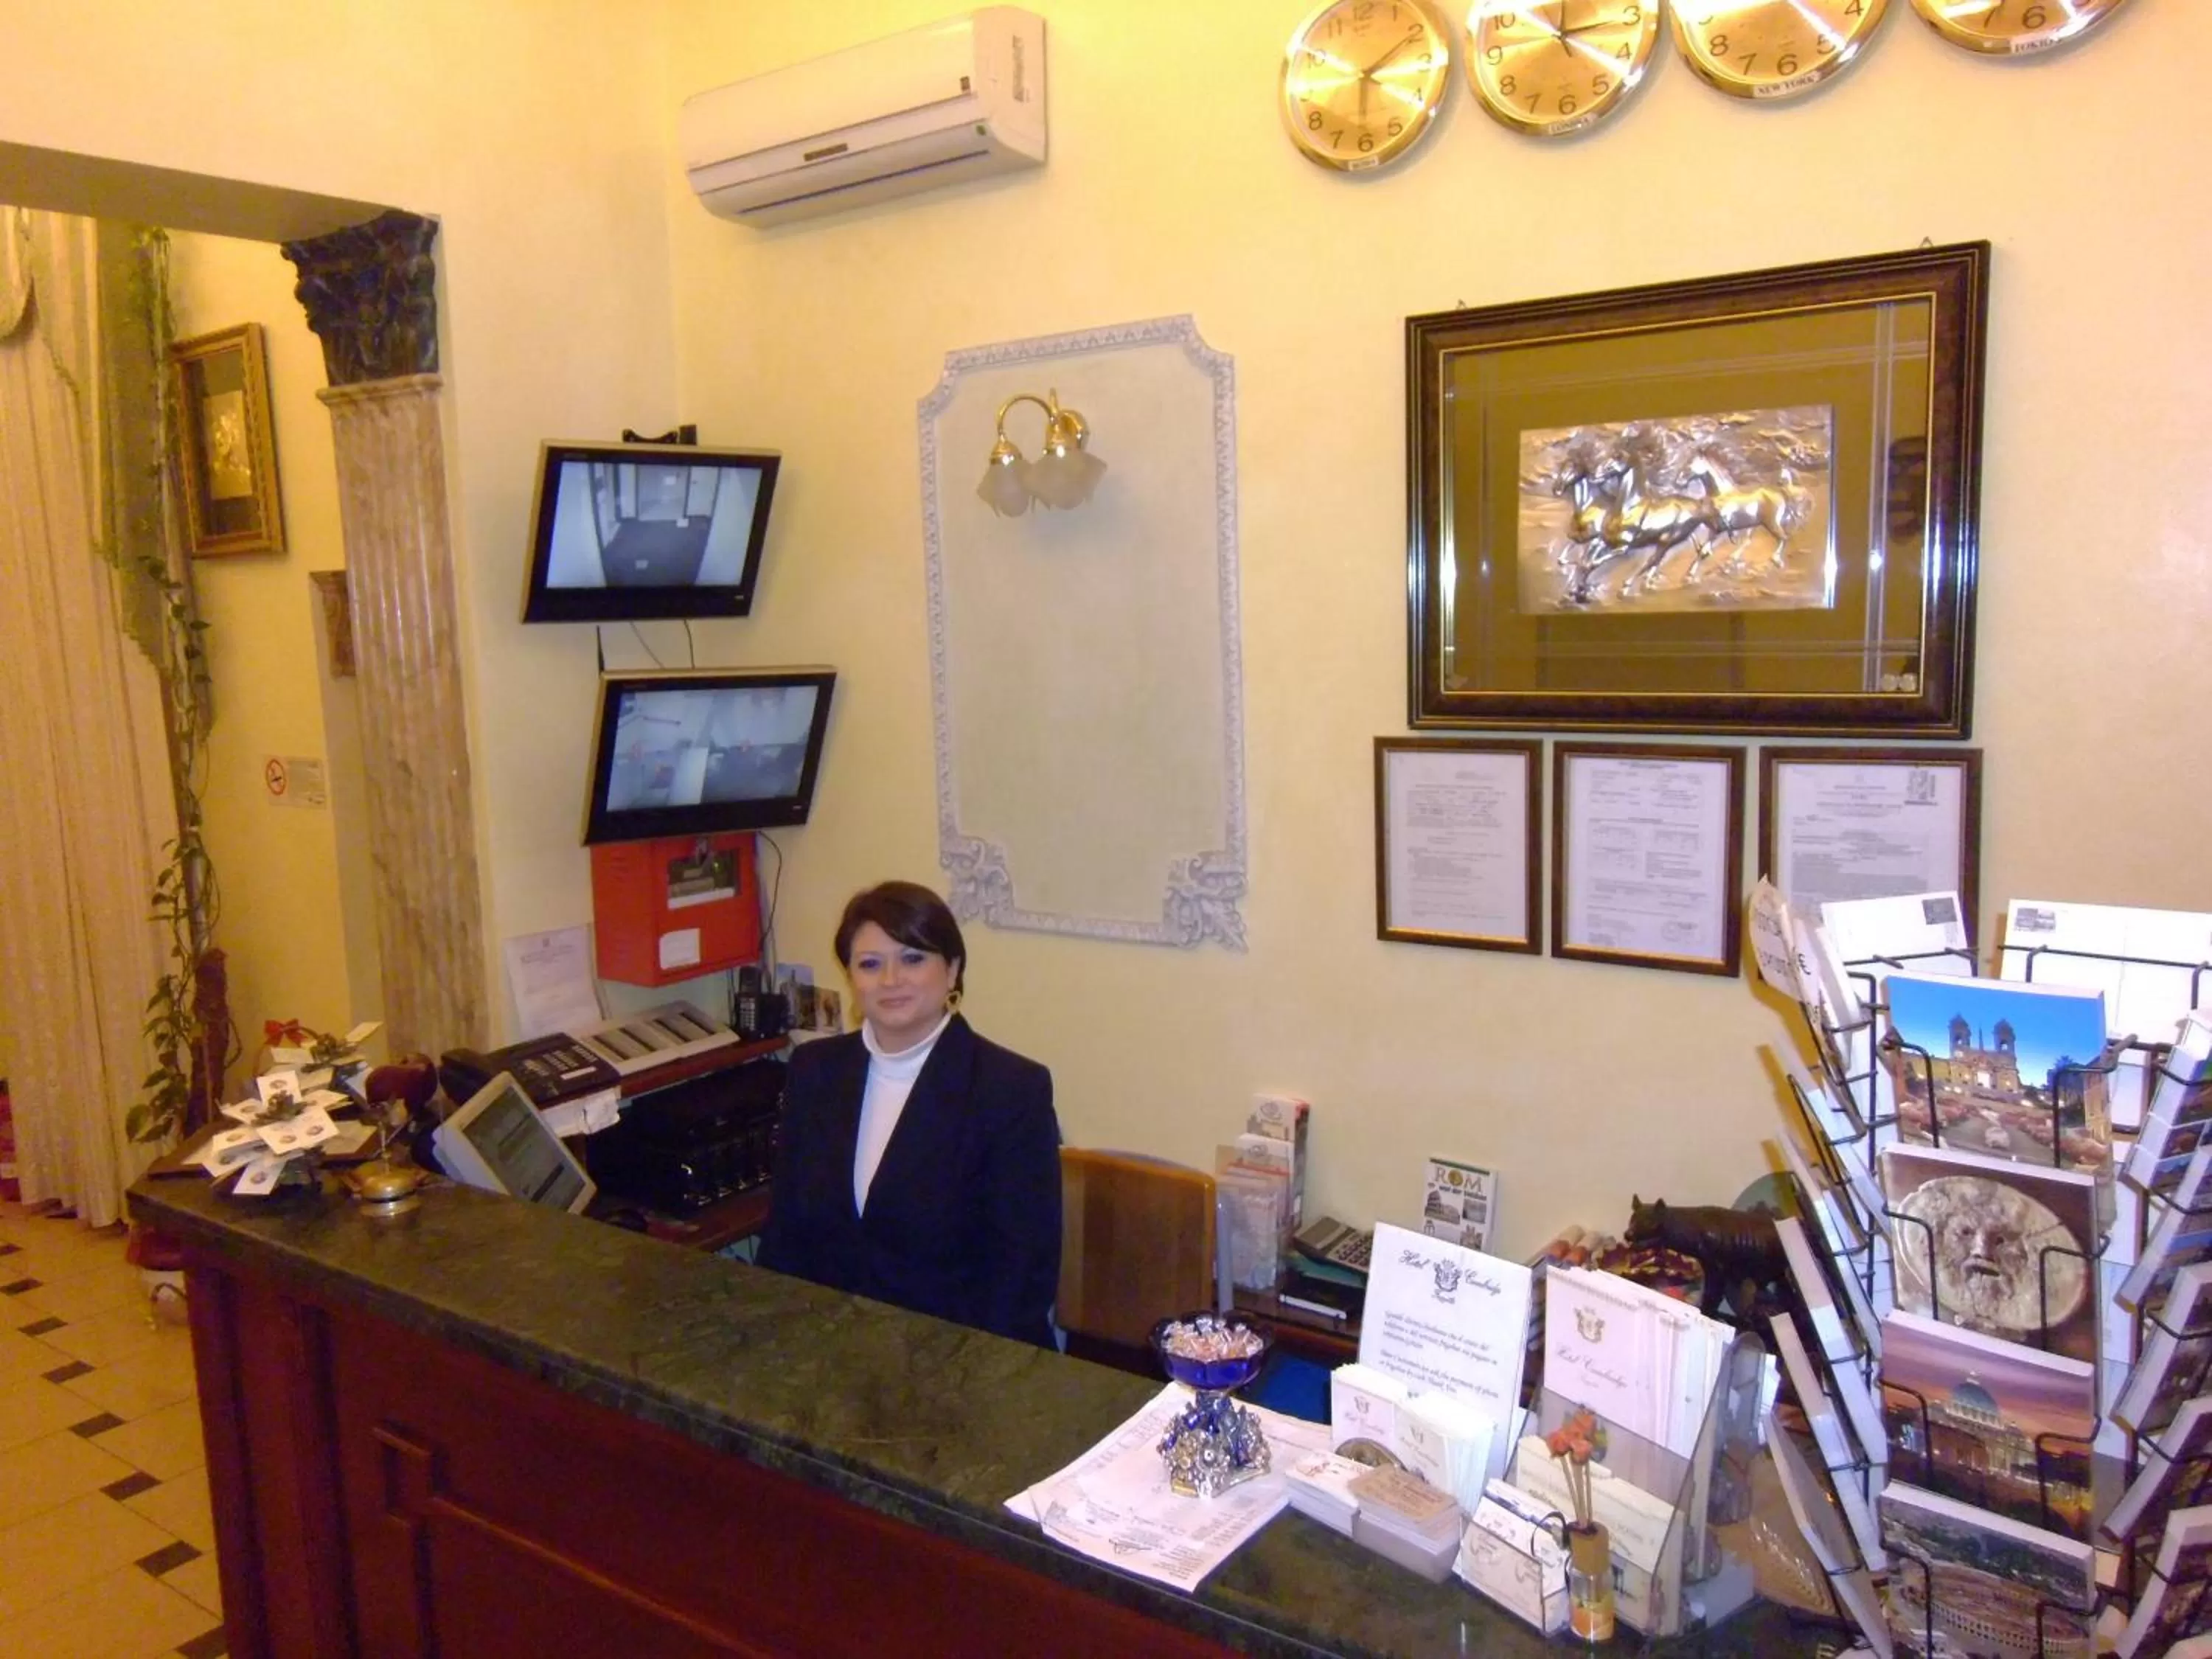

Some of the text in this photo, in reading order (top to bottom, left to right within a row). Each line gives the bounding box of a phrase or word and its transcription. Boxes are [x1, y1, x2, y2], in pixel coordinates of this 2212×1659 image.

[1353, 2, 1376, 21] 12
[1391, 5, 1399, 21] 1
[1622, 4, 1641, 27] 3
[2021, 5, 2048, 29] 6
[1327, 18, 1343, 38] 11
[1407, 24, 1425, 45] 2
[1486, 45, 1503, 66] 9
[1615, 41, 1632, 60] 4
[1709, 34, 1729, 58] 8
[1738, 52, 1759, 76] 7
[1775, 53, 1798, 76] 6
[1499, 74, 1517, 96] 8
[1591, 74, 1610, 96] 5
[1525, 92, 1543, 115] 7
[1557, 94, 1577, 116] 6
[1308, 111, 1324, 131] 8
[1387, 116, 1404, 138] 5
[1329, 129, 1345, 150] 7
[1357, 133, 1374, 153] 6
[1398, 1249, 1430, 1270] Hotel
